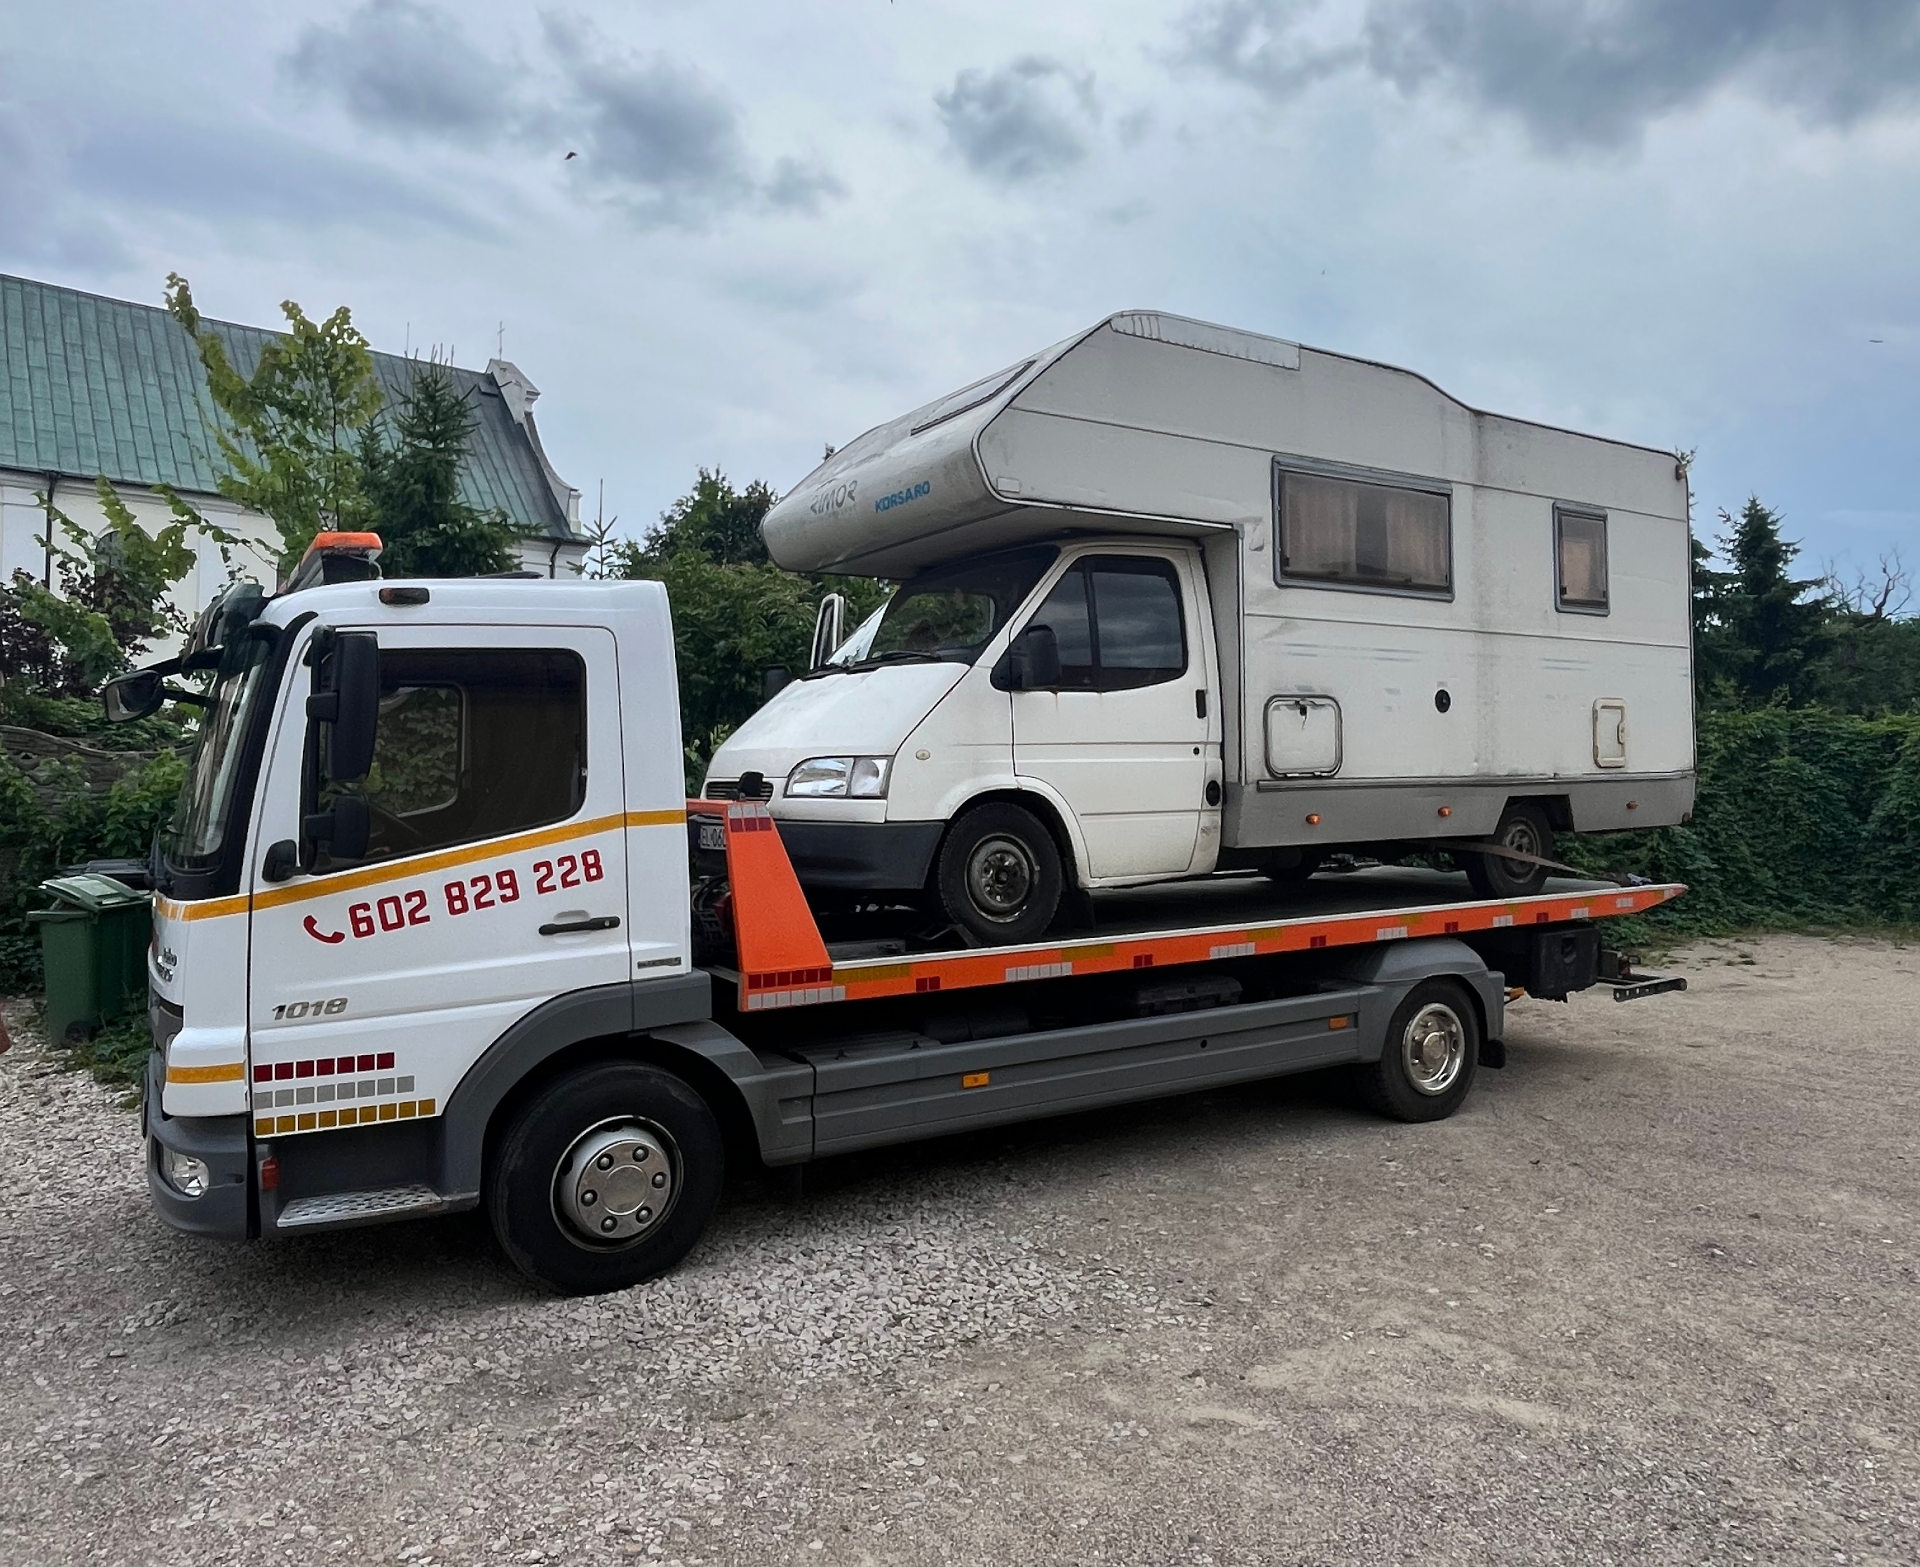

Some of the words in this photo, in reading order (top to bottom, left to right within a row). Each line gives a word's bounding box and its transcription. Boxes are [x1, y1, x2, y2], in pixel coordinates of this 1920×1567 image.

[875, 481, 931, 513] KORSARO
[349, 889, 431, 938] 602
[444, 869, 520, 916] 829
[533, 849, 604, 895] 228
[272, 997, 348, 1020] 1018
